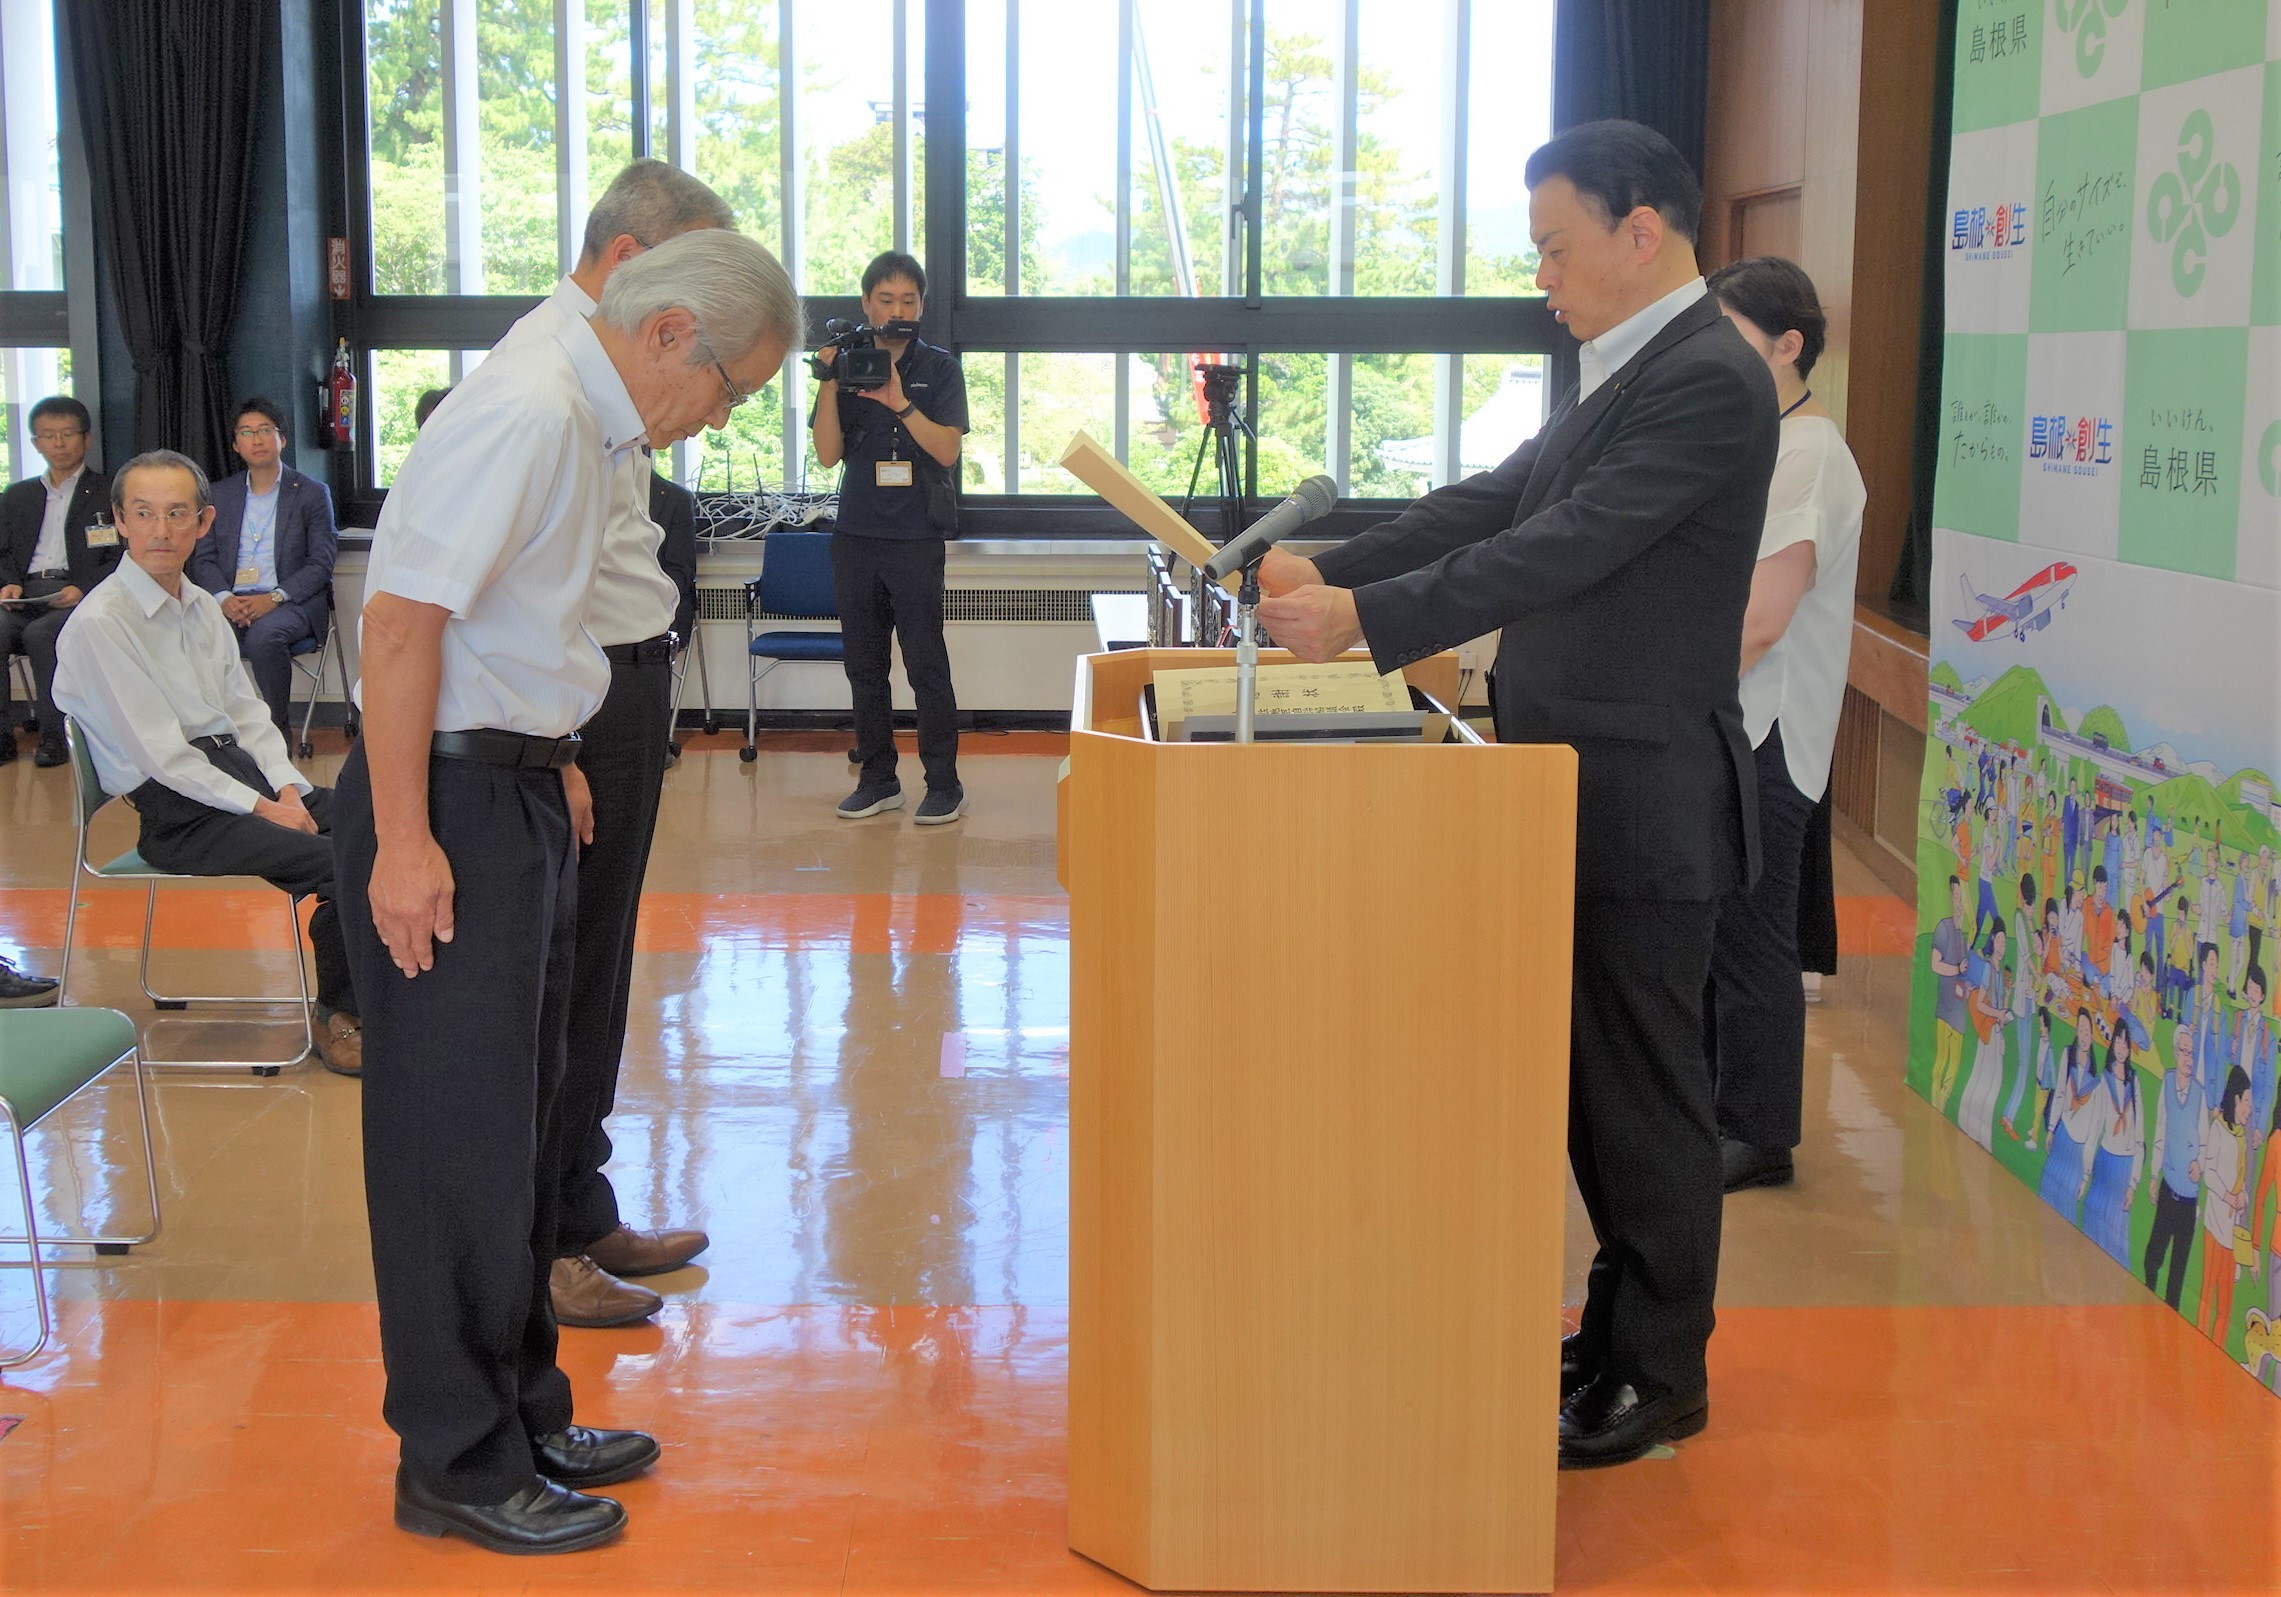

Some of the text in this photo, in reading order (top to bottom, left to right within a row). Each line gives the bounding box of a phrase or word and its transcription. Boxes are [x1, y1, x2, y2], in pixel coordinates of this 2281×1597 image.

[1970, 13, 2027, 64] 島根県
[331, 238, 347, 284] 消火器
[2043, 462, 2099, 477] SHIMANE SOUSEI
[2140, 444, 2217, 496] 島根県
